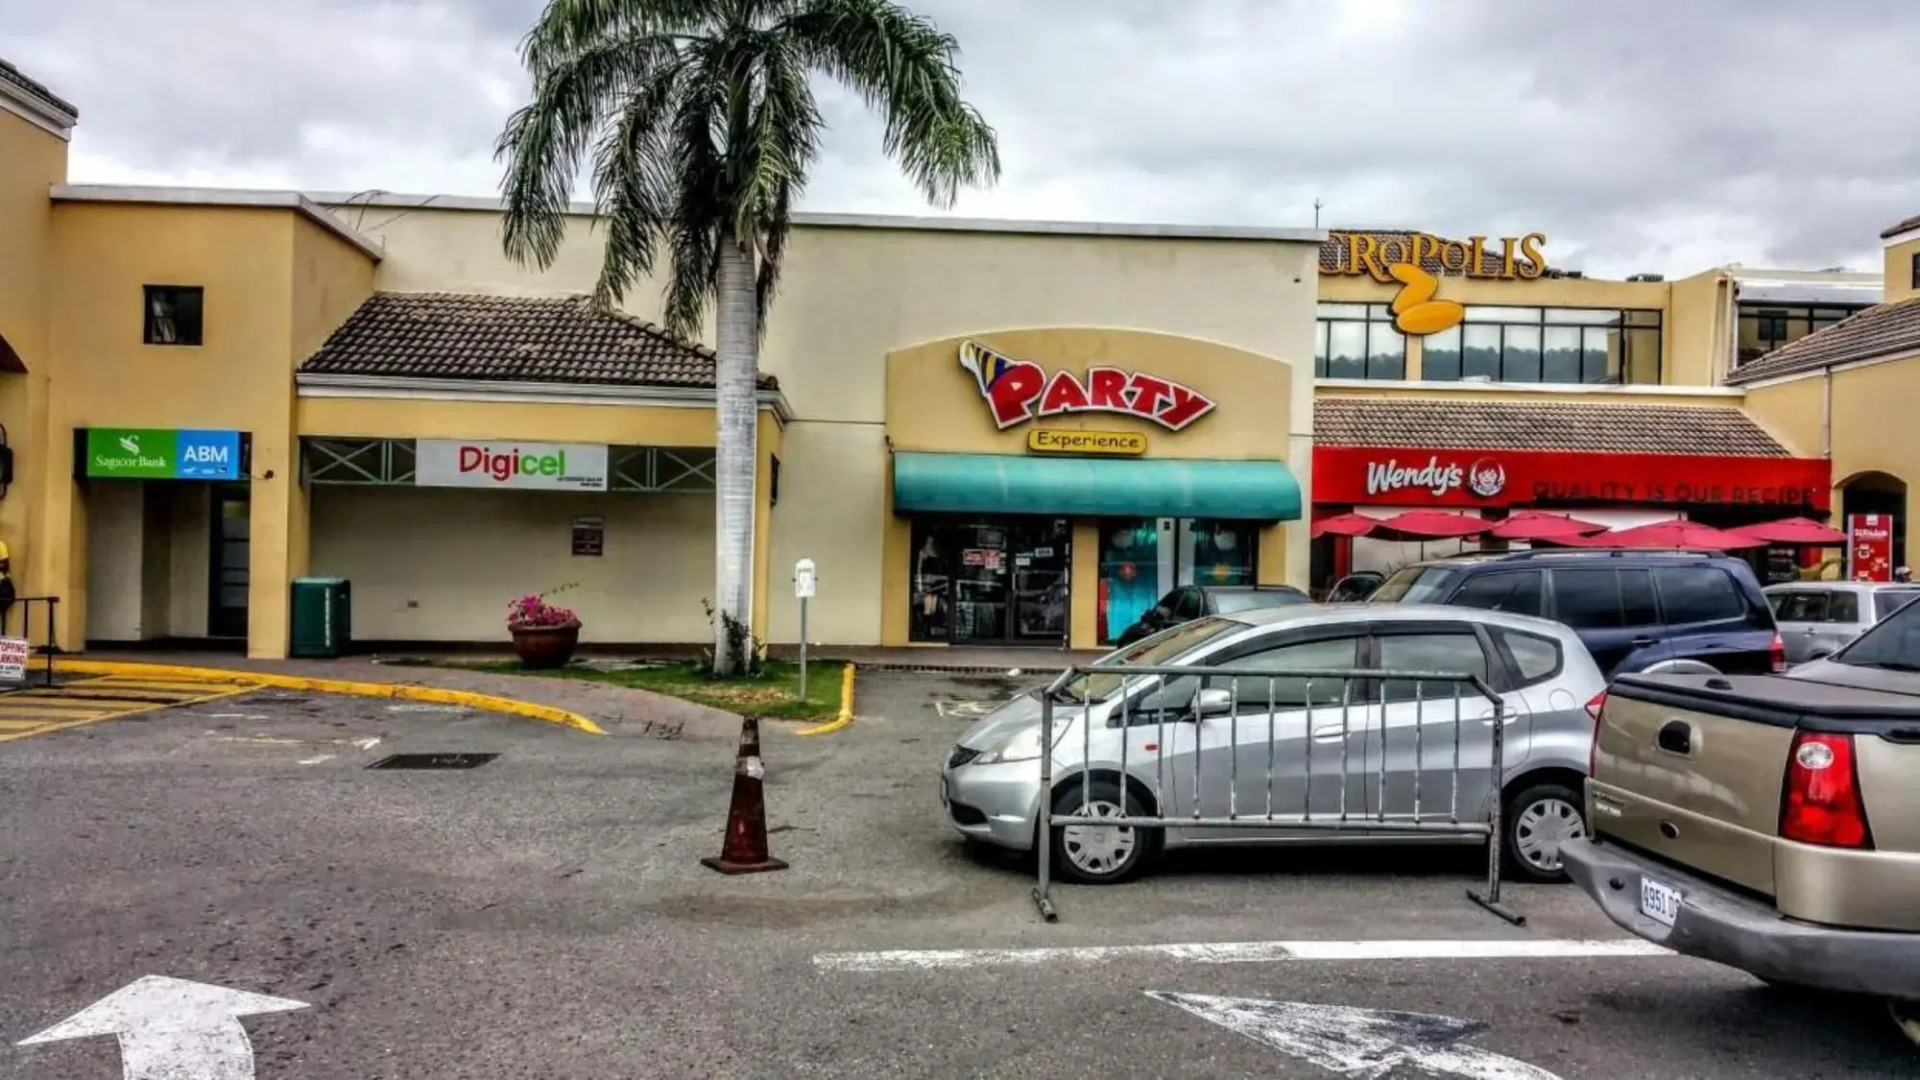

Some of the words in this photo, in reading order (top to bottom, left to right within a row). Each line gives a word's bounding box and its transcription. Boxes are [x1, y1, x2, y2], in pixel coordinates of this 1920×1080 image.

[987, 360, 1217, 431] PARTY
[1037, 431, 1139, 449] Experience
[95, 455, 137, 469] Sagicor
[138, 456, 167, 468] Bank
[183, 445, 229, 463] ABM
[459, 446, 566, 481] Digicel
[1367, 455, 1464, 496] Wendy's
